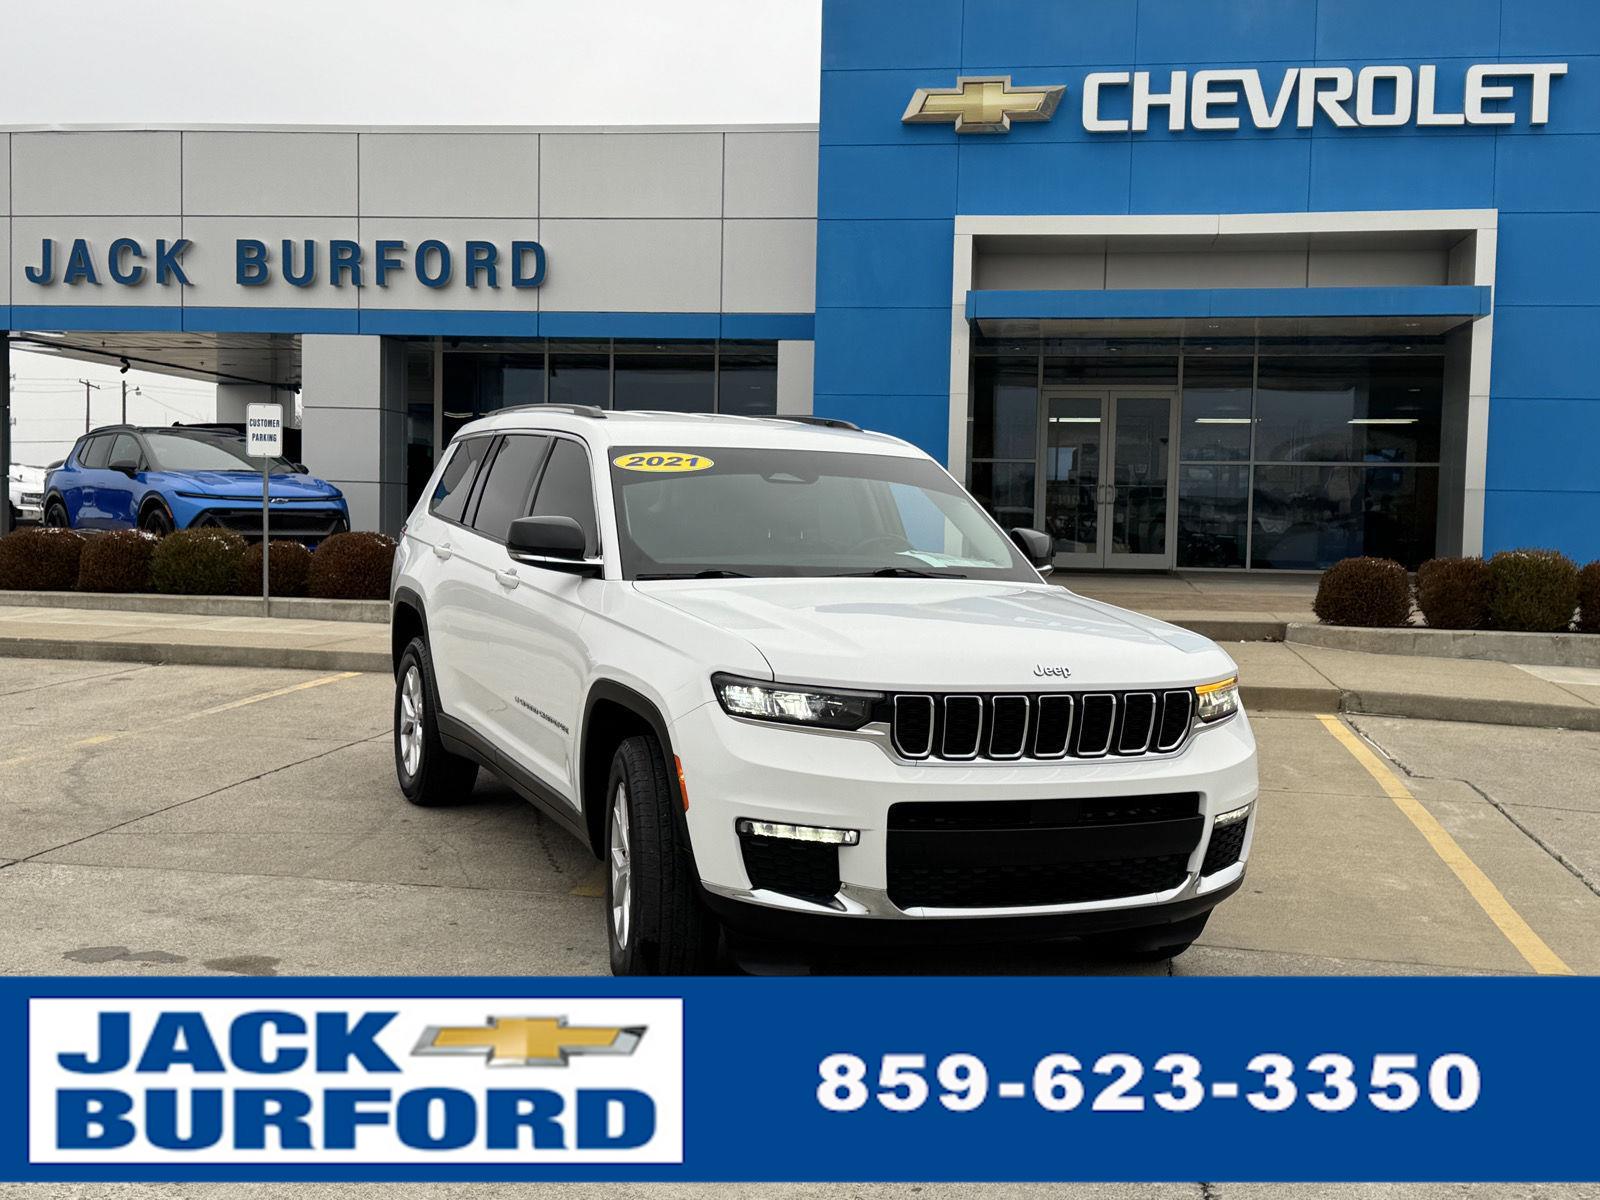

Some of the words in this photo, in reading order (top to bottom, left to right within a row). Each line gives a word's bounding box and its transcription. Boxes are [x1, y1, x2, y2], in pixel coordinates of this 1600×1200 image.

[1082, 63, 1567, 131] CHEVROLET
[25, 238, 193, 286] JACK
[236, 239, 547, 288] BURFORD
[249, 418, 280, 428] CUSTOMER
[252, 433, 277, 442] PARKING
[625, 456, 699, 467] 2021
[1033, 664, 1072, 679] Jeep
